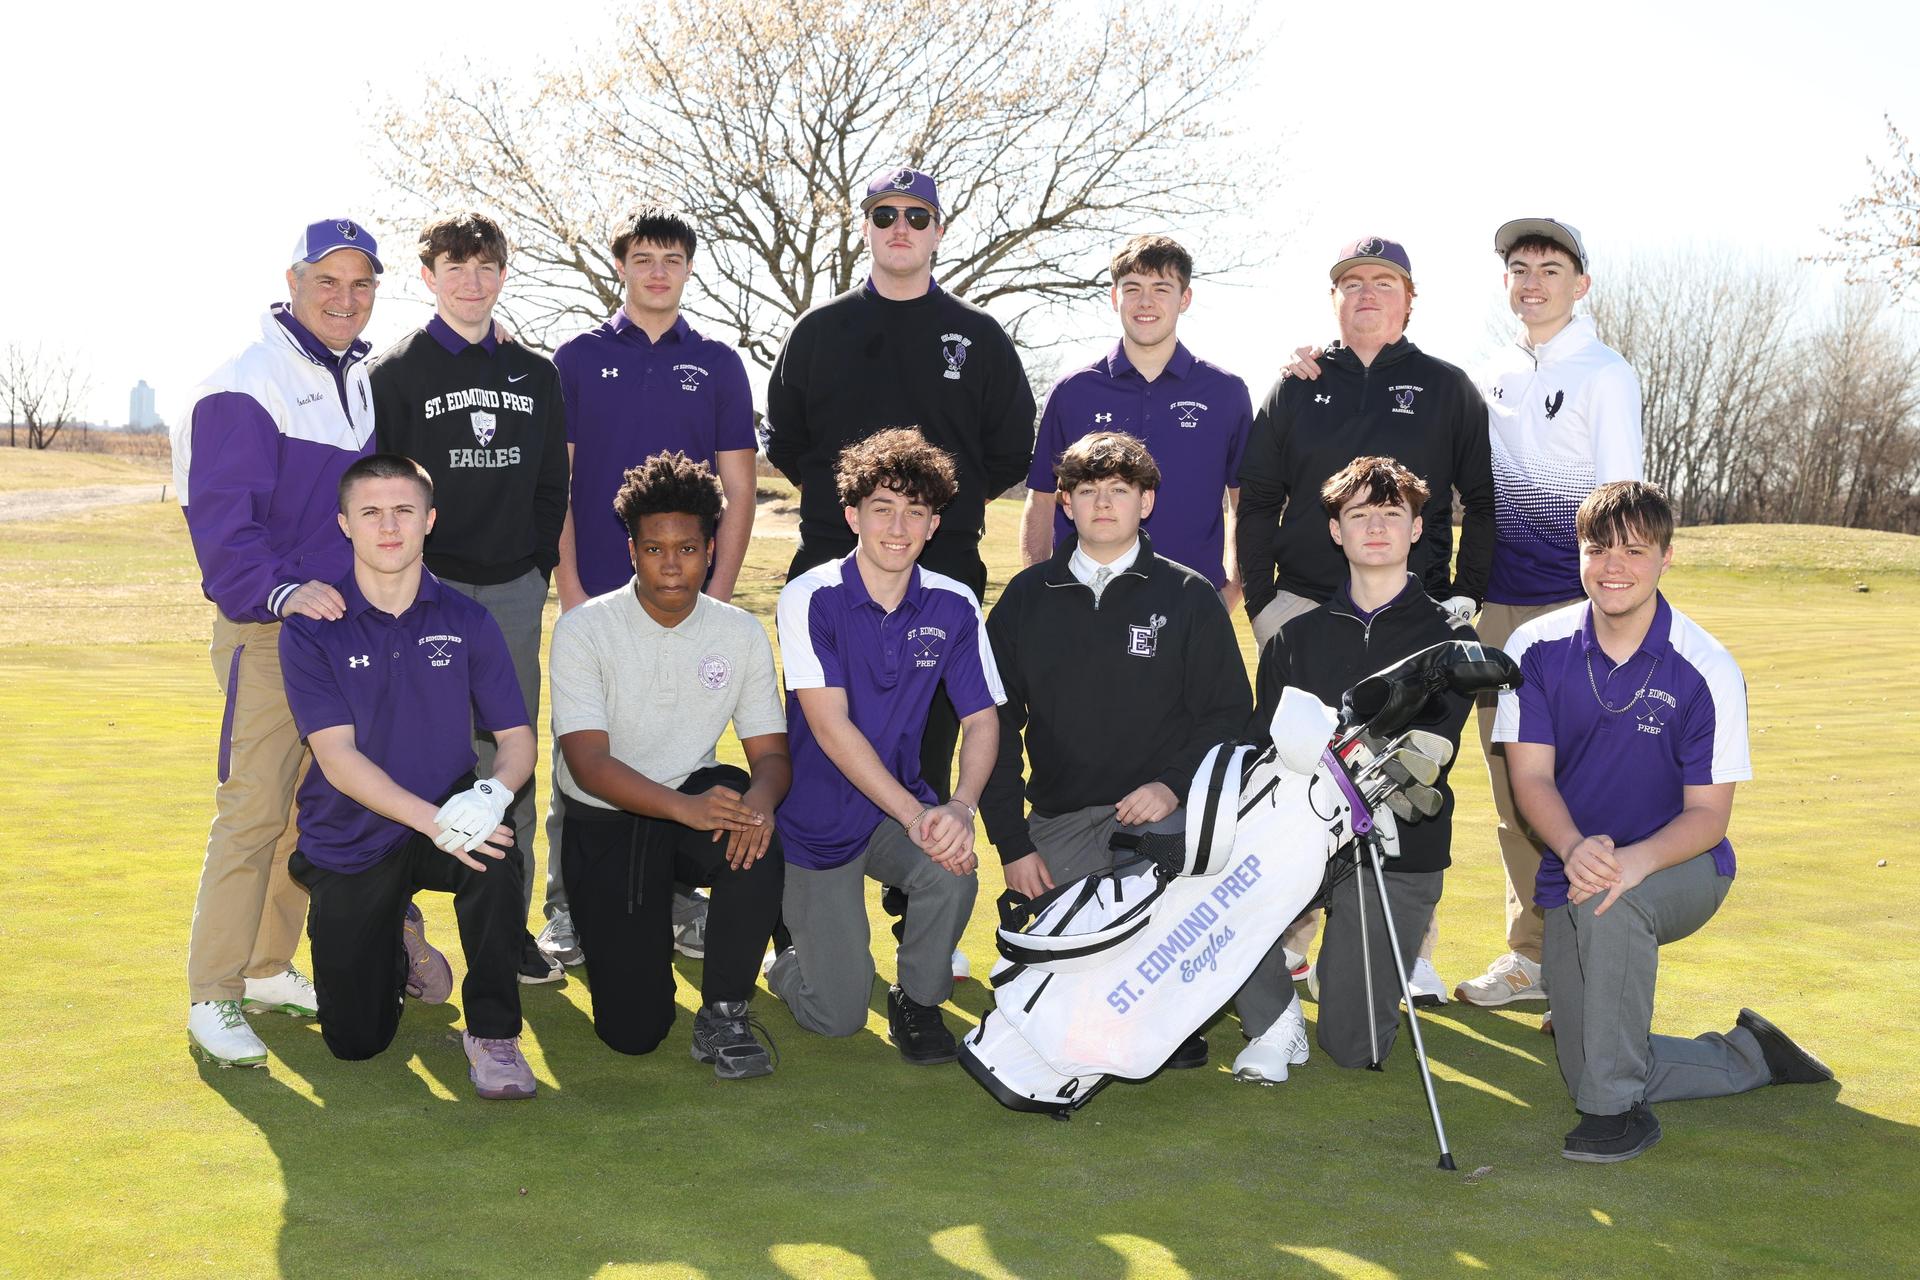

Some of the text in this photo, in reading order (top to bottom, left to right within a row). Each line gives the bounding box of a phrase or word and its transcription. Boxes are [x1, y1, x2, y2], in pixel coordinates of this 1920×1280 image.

[425, 397, 446, 420] ST.
[445, 388, 500, 412] EDMUND
[448, 446, 521, 468] EAGLES
[907, 626, 947, 641] ST. EDMUND
[1128, 624, 1154, 658] E
[431, 659, 451, 667] GOLF
[916, 660, 937, 668] PREP
[1647, 688, 1677, 709] EDMUND
[1636, 723, 1662, 735] PREP
[1106, 854, 1263, 1015] ST. EDMUND PREP
[1179, 925, 1236, 984] Eagles
[1503, 968, 1533, 993] N
